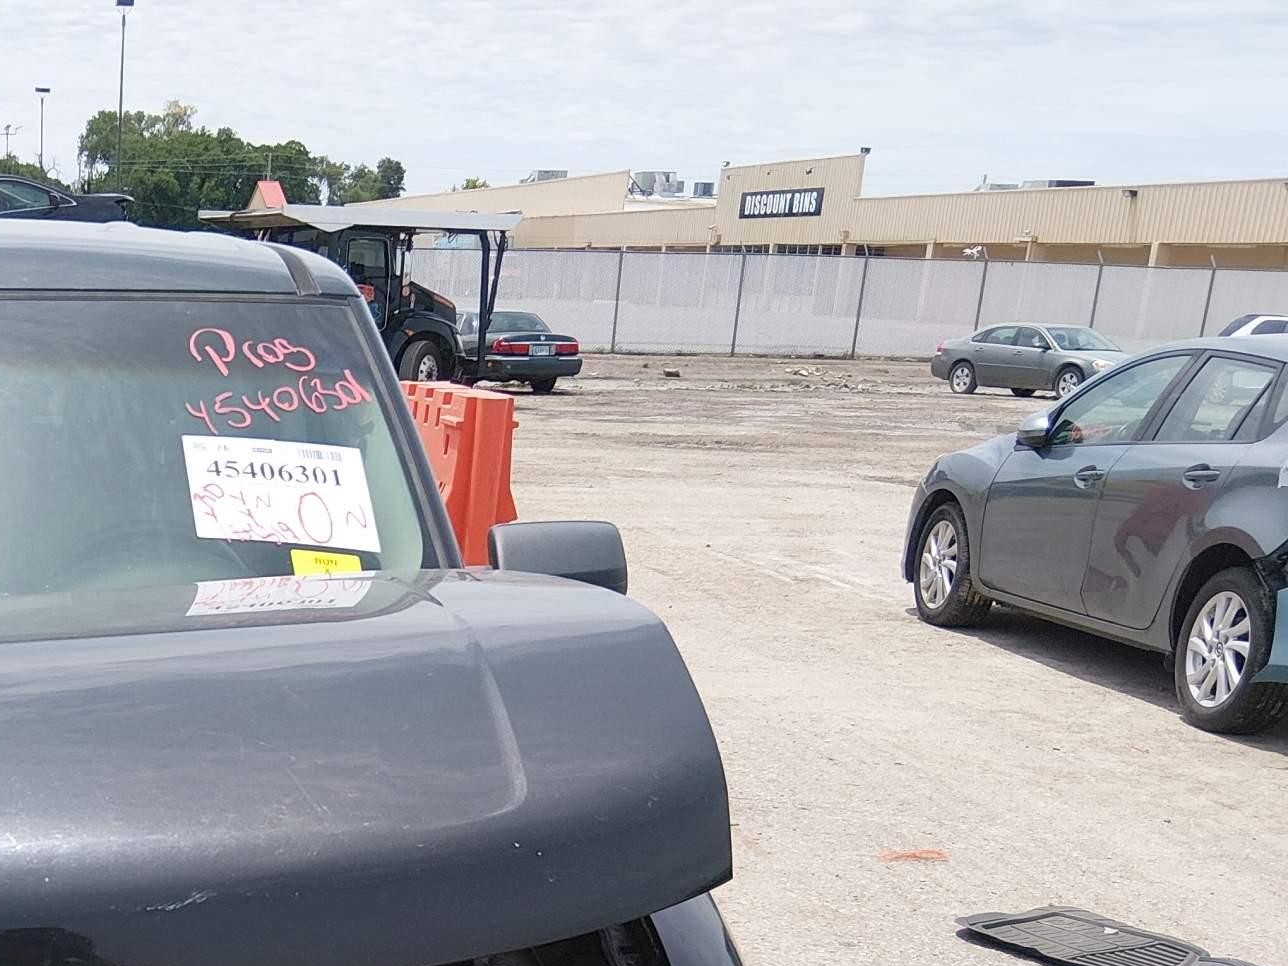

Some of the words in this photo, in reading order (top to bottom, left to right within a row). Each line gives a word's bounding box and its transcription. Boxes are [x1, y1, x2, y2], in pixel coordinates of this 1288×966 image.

[744, 193, 792, 216] DISCOUNT
[792, 191, 818, 214] BINS
[206, 460, 343, 487] 45406301
